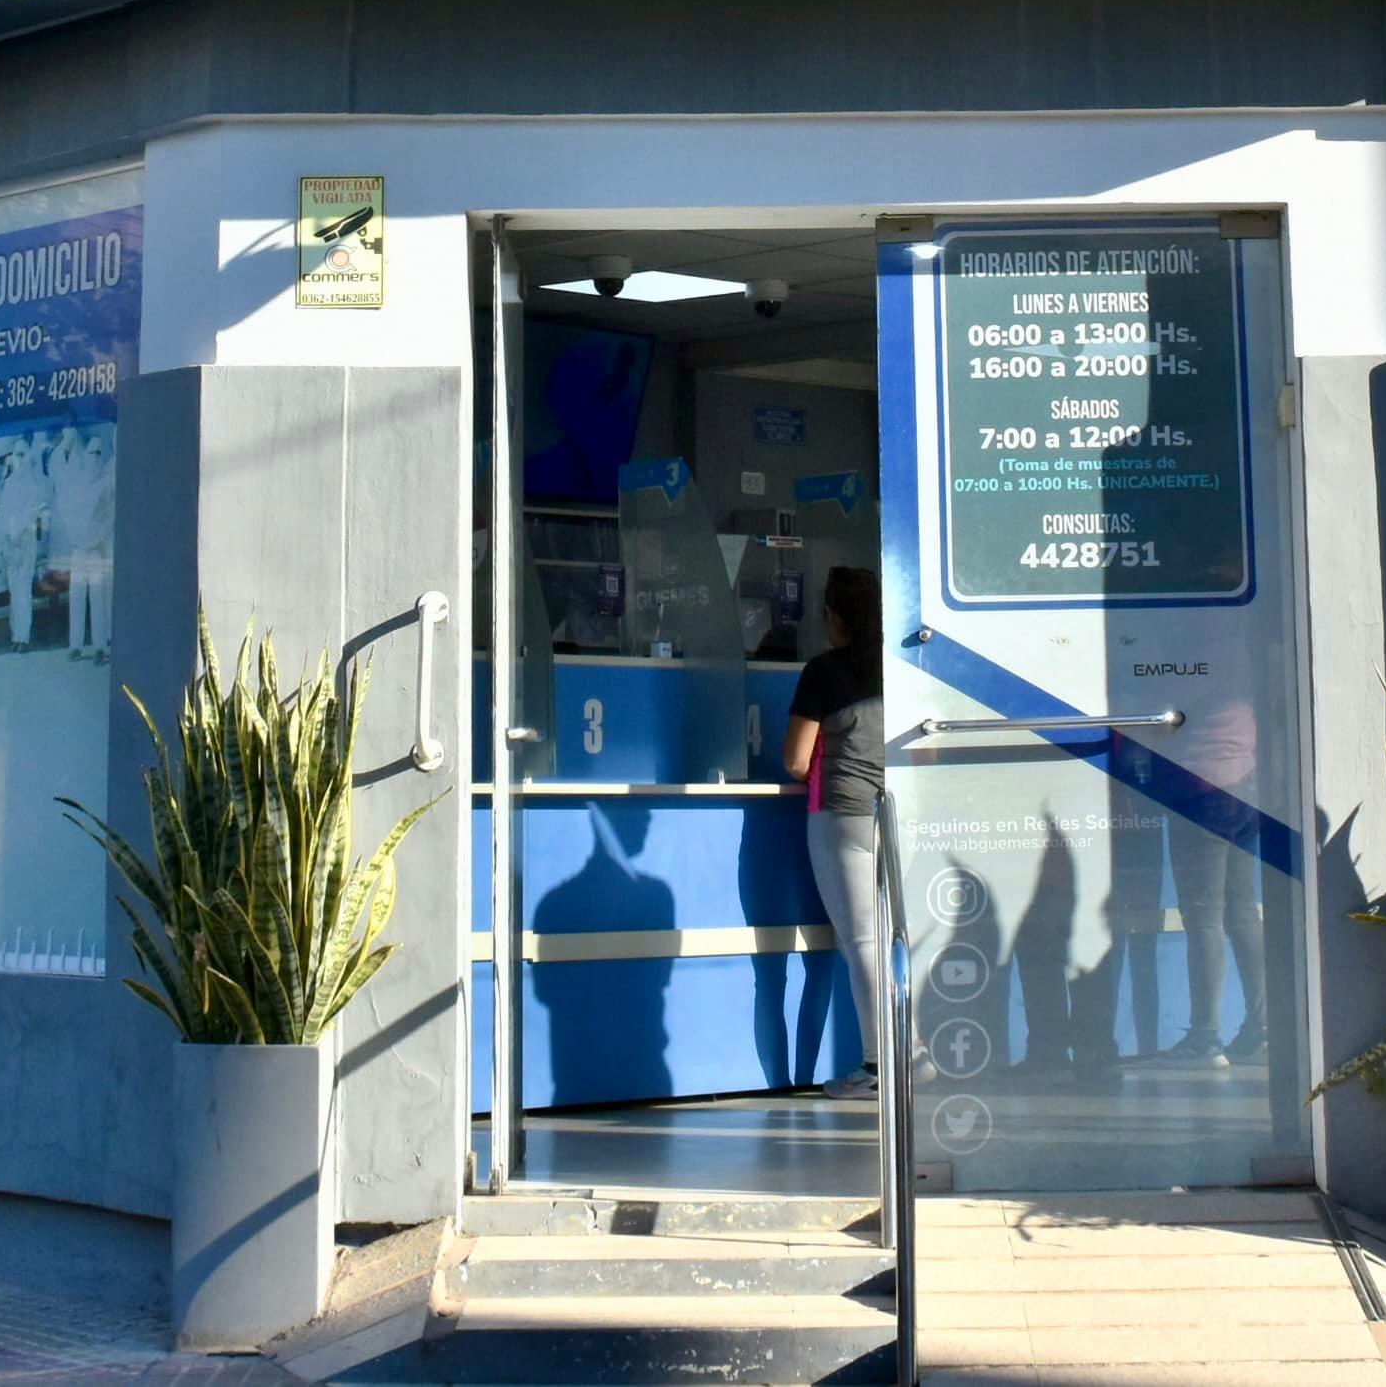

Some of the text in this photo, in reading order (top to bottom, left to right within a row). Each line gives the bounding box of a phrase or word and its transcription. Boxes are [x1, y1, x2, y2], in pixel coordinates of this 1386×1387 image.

[304, 179, 381, 192] PROPIEDAD
[313, 192, 373, 204] VIGILADA
[960, 244, 1201, 279] HORARIOS DE ATENCIÓN:
[302, 272, 379, 283] commer's
[1013, 292, 1149, 315] LUNES A VIERNES
[968, 321, 1197, 346] 06:00 a 13:00 Hs.
[970, 354, 1198, 379] 16:00 a 20:00 Hs.
[8, 374, 34, 408] 362
[48, 362, 116, 401] 4220158
[1050, 396, 1120, 420] SÁBADOS
[979, 425, 1193, 450] 7:00 a 12:00 Hs.
[999, 456, 1176, 474] (Toma de muestras de
[954, 474, 1220, 493] 07:00 a 10:00 Hs. ÚNICAMENTE.)
[1042, 513, 1135, 535] CONSULTAS:
[1020, 541, 1160, 568] 4428751
[1134, 662, 1209, 677] EMPUJE
[583, 698, 603, 753] 3
[906, 818, 989, 838] Seguinos
[996, 820, 1018, 832] en
[1024, 815, 1080, 832] Redes
[907, 835, 1094, 854] www.labguemes.com.ar
